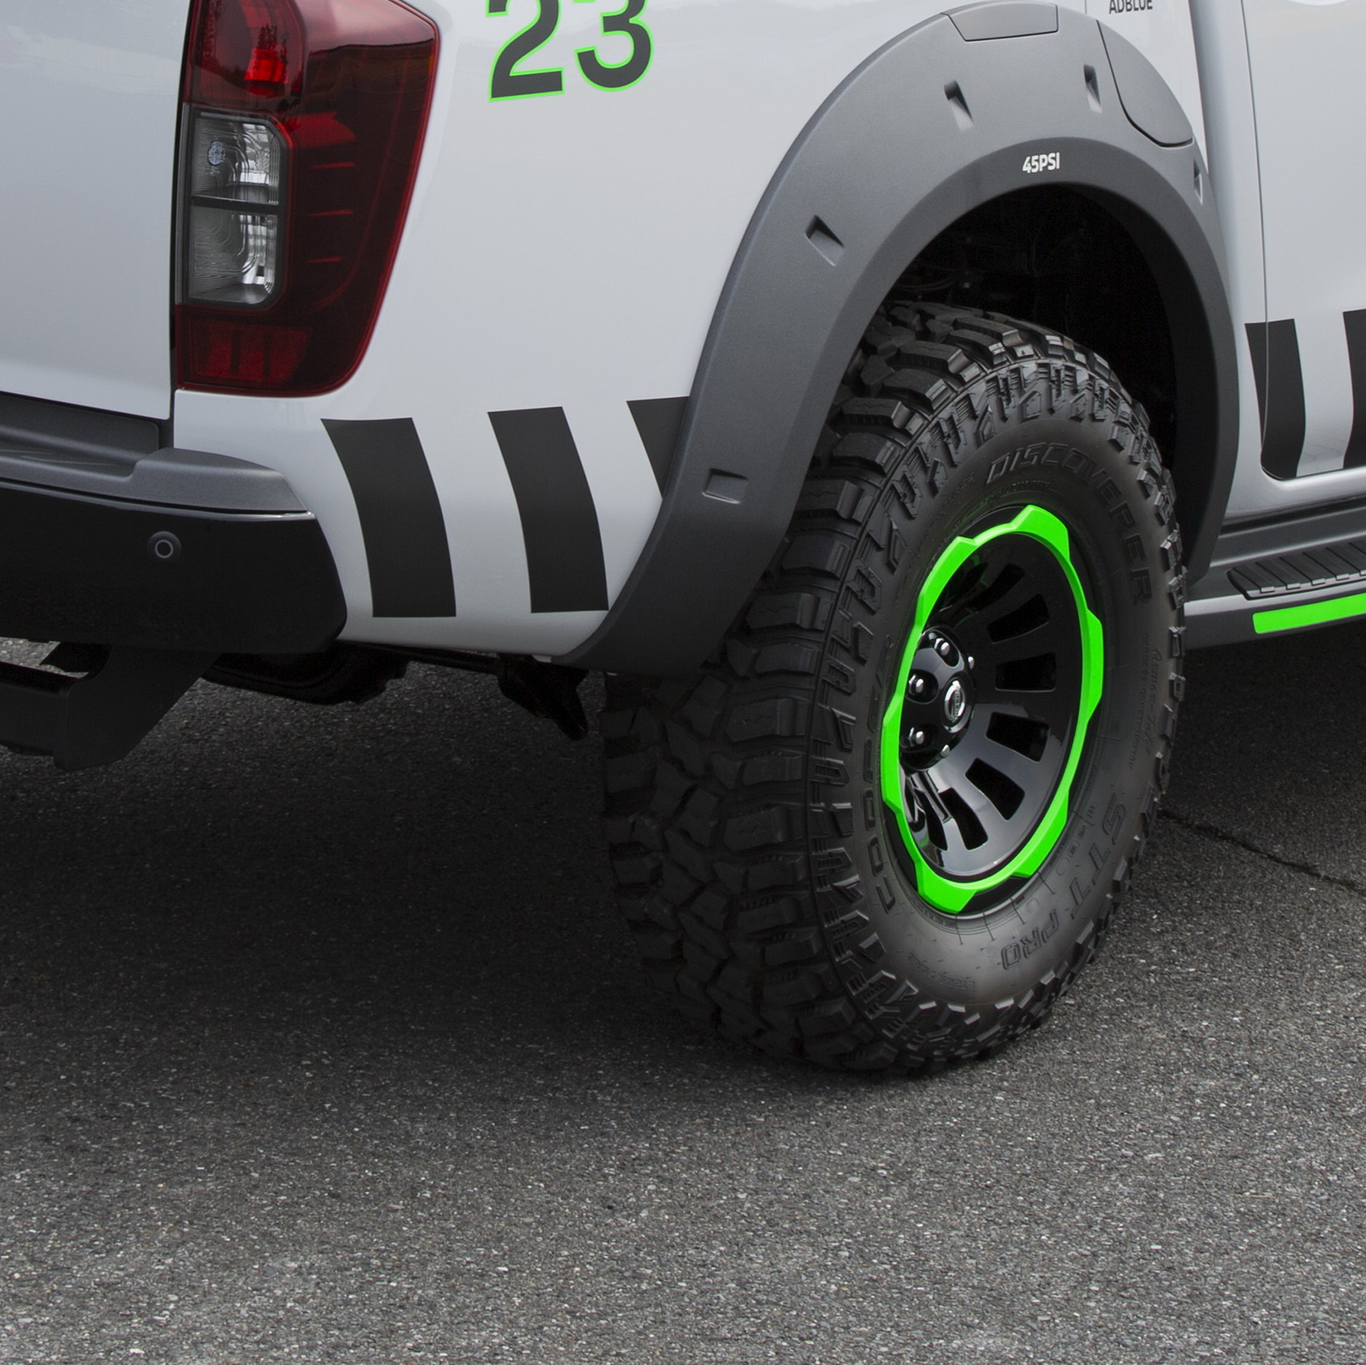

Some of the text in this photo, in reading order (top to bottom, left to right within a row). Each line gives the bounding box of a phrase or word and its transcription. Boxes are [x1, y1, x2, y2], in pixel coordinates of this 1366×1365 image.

[1022, 152, 1061, 174] 45PSI
[986, 441, 1153, 605] DISCOVERER
[1000, 792, 1127, 971] STT PRO
